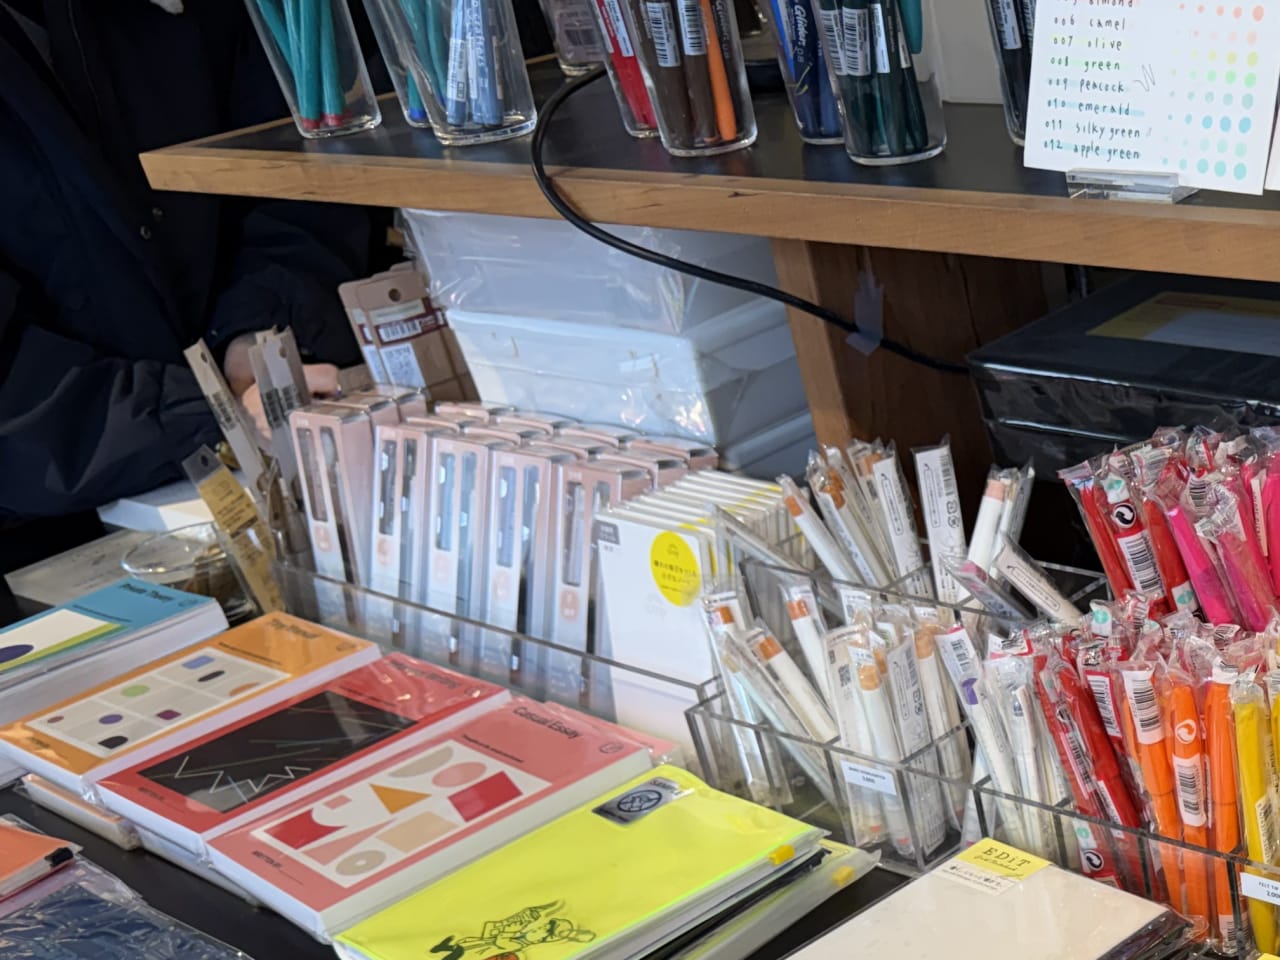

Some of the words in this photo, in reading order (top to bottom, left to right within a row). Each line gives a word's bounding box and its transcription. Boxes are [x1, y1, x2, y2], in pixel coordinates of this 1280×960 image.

[1089, 18, 1126, 30] camel
[1087, 37, 1122, 51] olive
[1084, 60, 1120, 72] green
[1080, 78, 1124, 93] peacock
[1078, 102, 1130, 116] emerald
[1076, 122, 1105, 139] silky
[1110, 127, 1140, 140] green
[1073, 141, 1100, 158] apple
[1107, 148, 1140, 163] green
[513, 706, 549, 725] Casual
[547, 721, 580, 739] Essay
